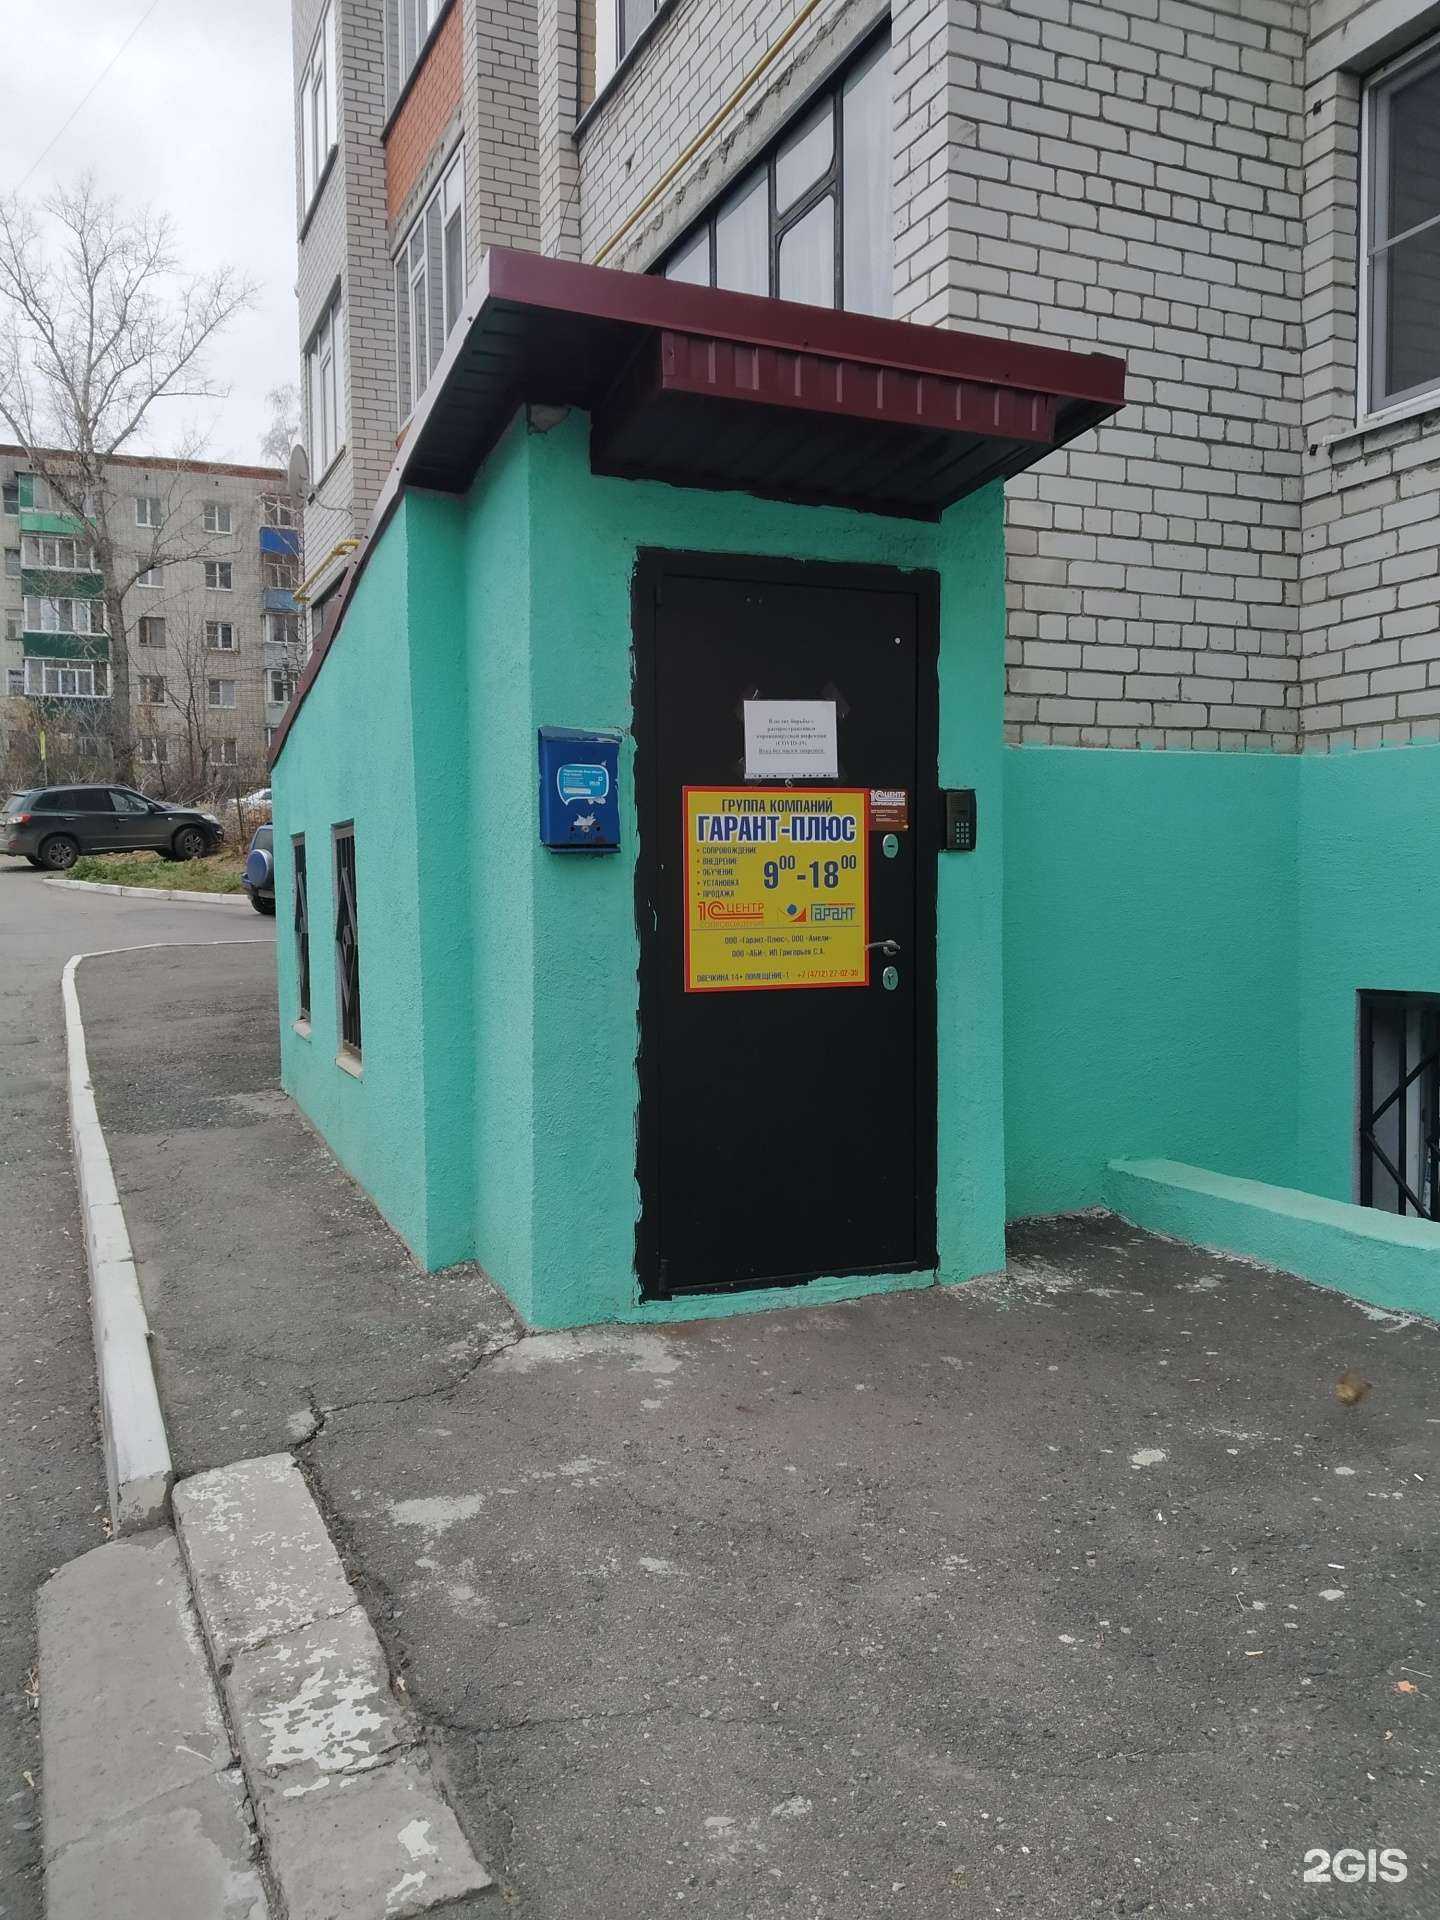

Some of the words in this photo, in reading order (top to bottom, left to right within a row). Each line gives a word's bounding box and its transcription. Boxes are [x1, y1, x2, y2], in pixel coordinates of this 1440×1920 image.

[722, 799, 766, 812] ГРУППА
[770, 797, 833, 812] КОМПАНИЙ
[697, 815, 856, 842] ГАРАНТ-ПЛЮС
[703, 879, 739, 887] УСТАНОВКА
[703, 890, 735, 898] ПРОДАЖА
[727, 903, 764, 913] ЦЕНТР
